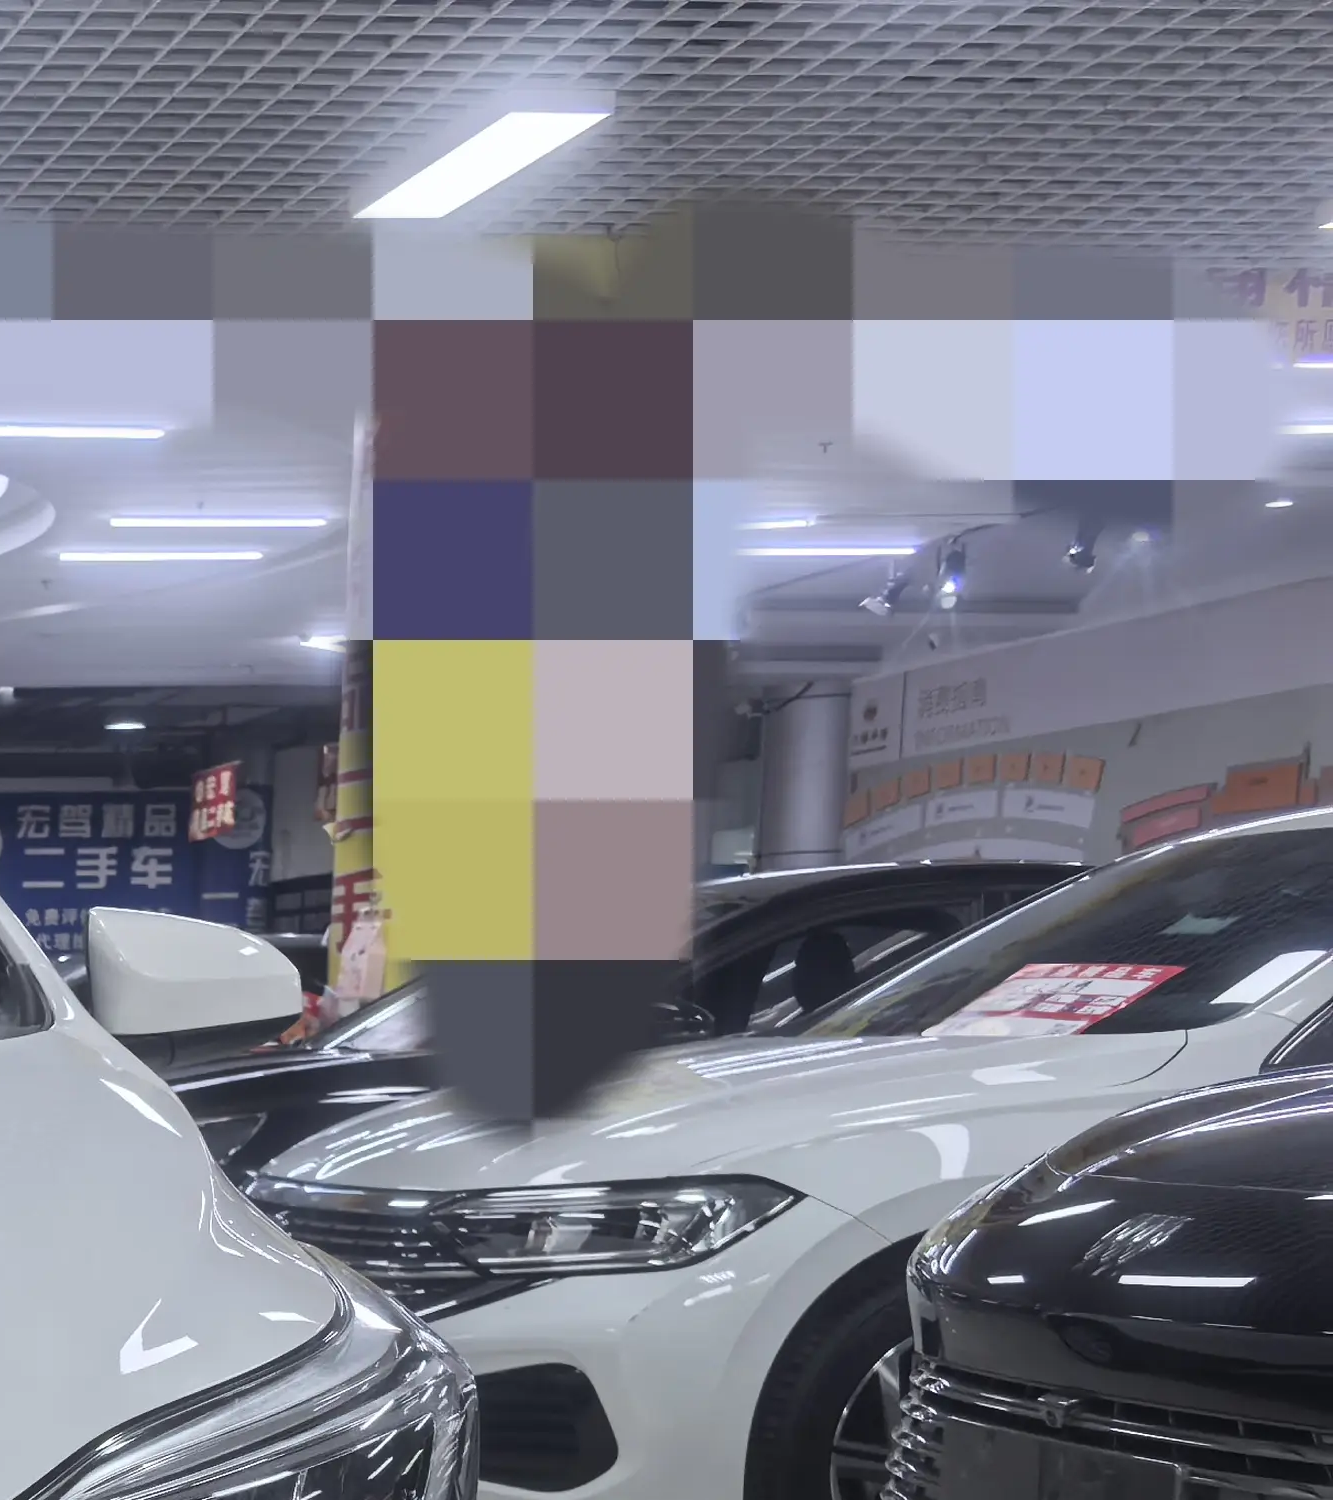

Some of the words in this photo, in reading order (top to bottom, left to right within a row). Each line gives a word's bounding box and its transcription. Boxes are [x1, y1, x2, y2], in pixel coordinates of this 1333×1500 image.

[16, 803, 177, 839] 宏驾精品
[22, 846, 174, 890] 二手车
